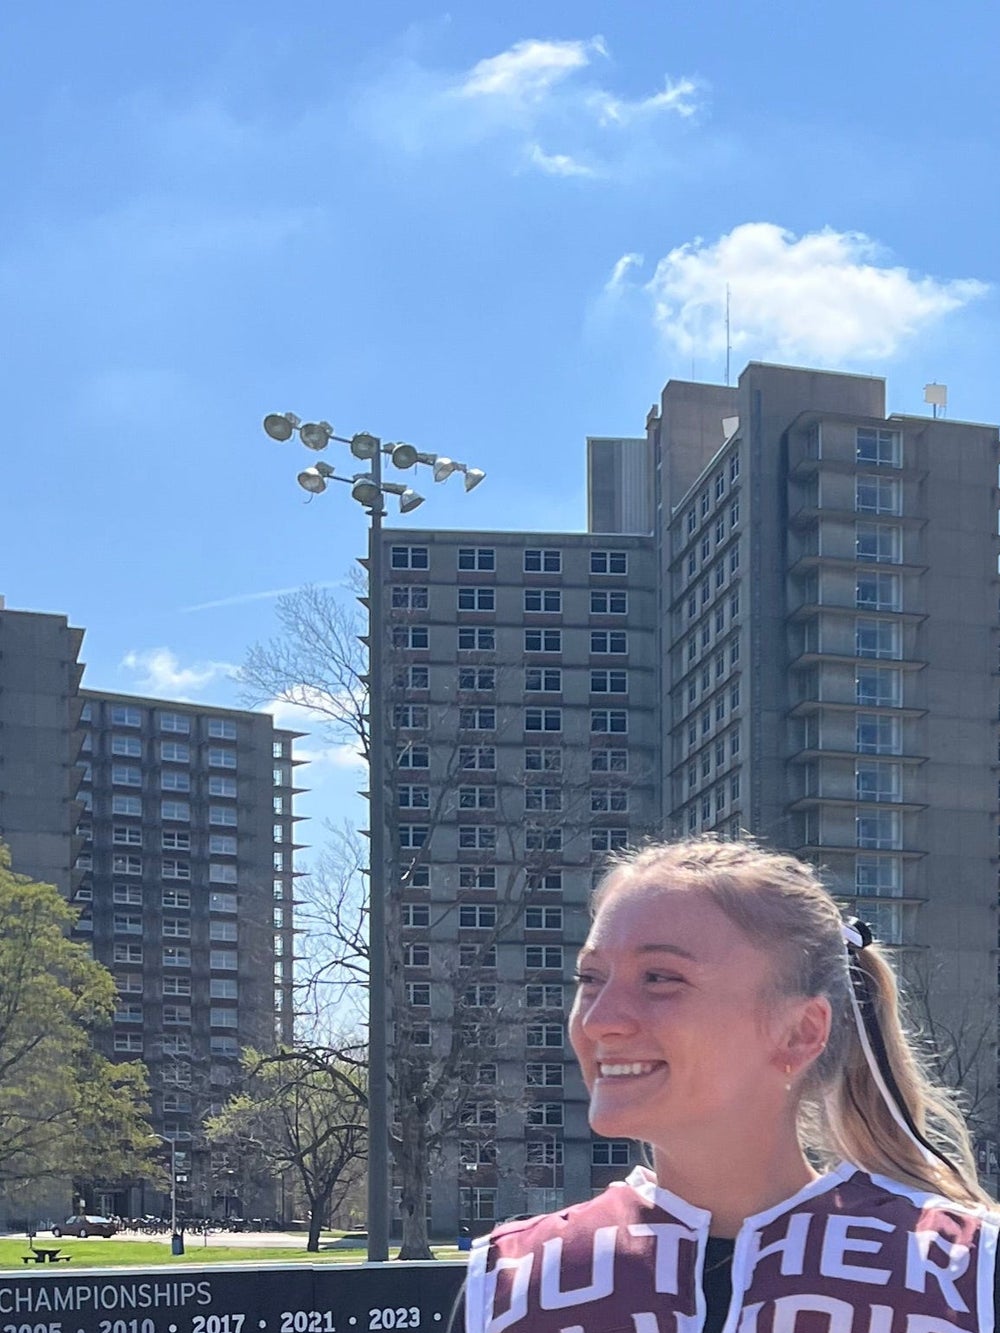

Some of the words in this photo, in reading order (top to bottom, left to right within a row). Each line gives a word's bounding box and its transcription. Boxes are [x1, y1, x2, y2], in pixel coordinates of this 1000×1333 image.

[0, 1281, 212, 1313] CHAMPIONSHIPS
[280, 1310, 336, 1333] 2021
[368, 1306, 421, 1331] 2023
